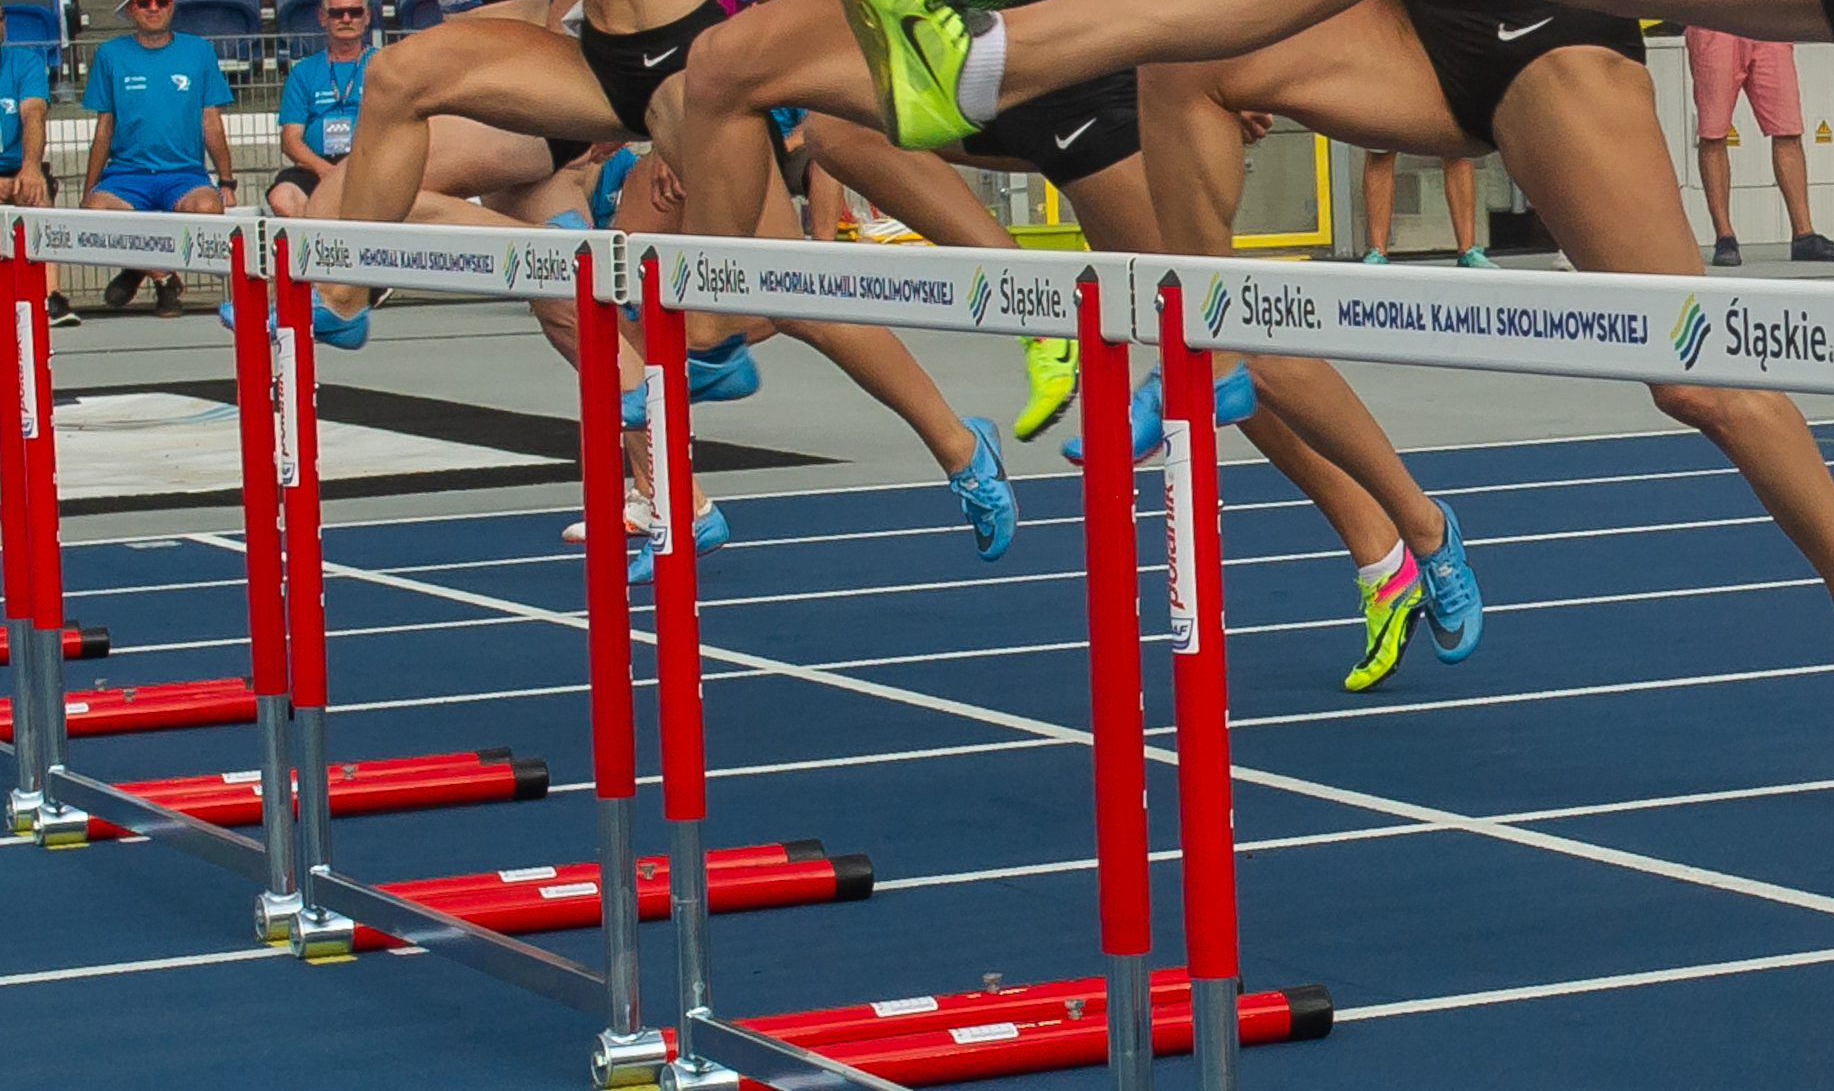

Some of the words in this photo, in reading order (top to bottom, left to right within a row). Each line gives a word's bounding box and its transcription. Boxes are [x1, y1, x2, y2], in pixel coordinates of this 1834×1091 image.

[759, 270, 816, 295] MEMORIAŁ
[818, 273, 857, 297] KAMILI
[859, 275, 954, 305] SKOLIMOWSKIEJ
[999, 260, 1067, 325] Śląskie.
[1241, 276, 1323, 339] Śląskie.
[1337, 299, 1427, 332] MEMORIAŁ
[1431, 304, 1492, 336] KAMILI
[1496, 306, 1648, 345] SKOLIMOWSKIEJ
